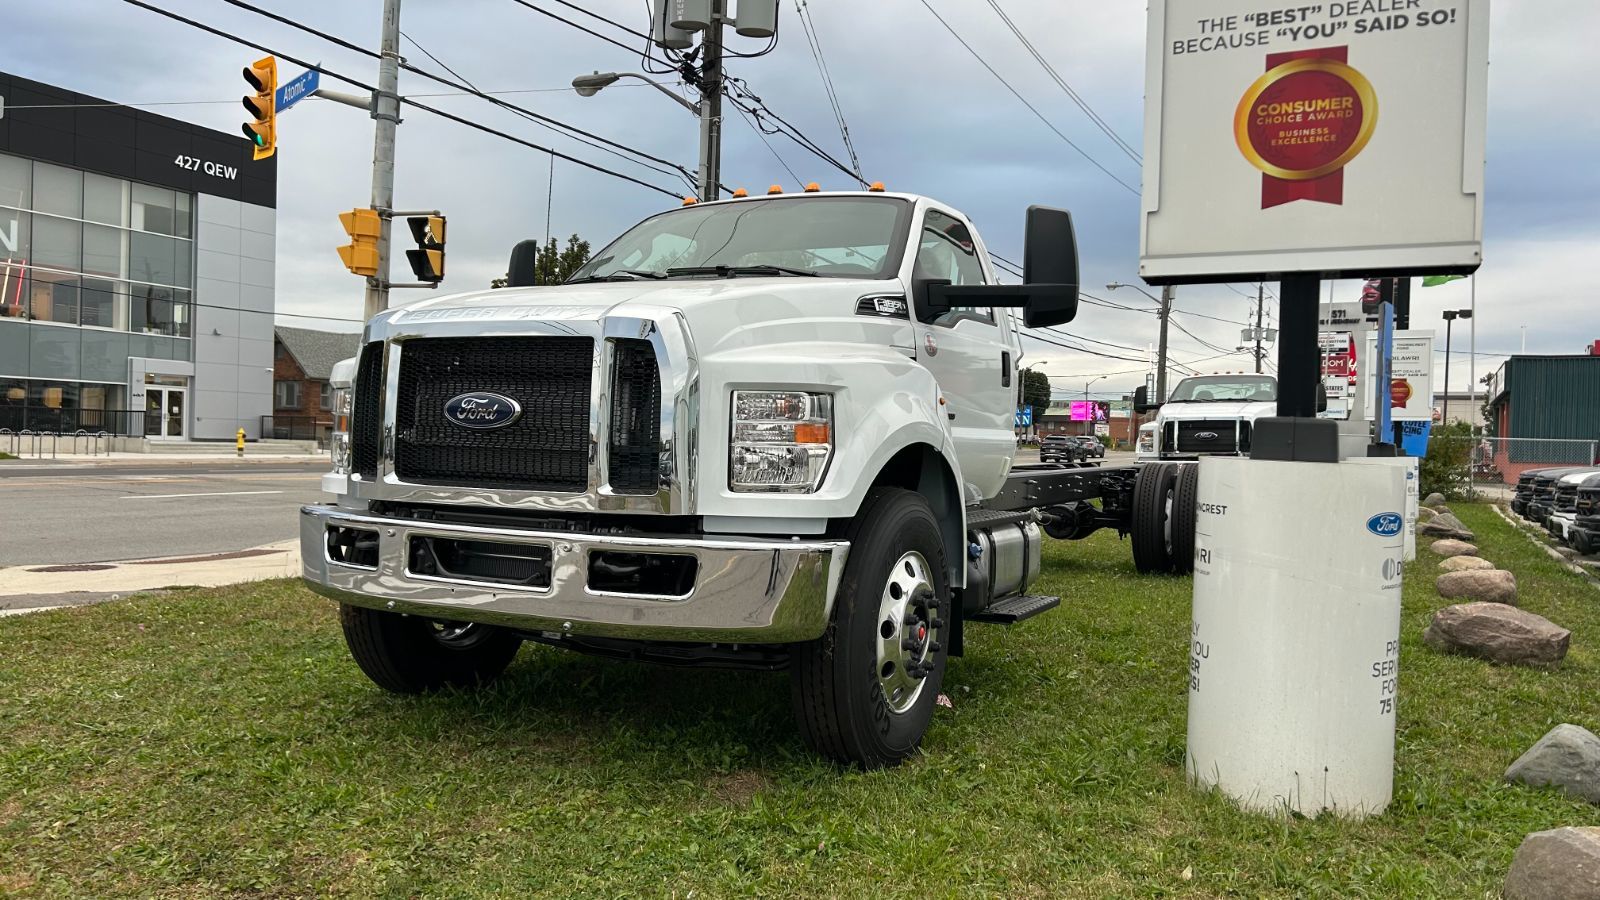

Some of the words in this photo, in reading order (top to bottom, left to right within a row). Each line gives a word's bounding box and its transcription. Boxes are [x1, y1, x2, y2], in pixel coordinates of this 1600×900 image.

[1198, 16, 1237, 34] THE
[1329, 0, 1420, 18] DEALER
[1173, 30, 1270, 55] BECAUSE
[1354, 14, 1409, 34] SAID
[1416, 8, 1456, 27] SO!
[283, 76, 306, 104] Atomic
[1256, 114, 1302, 125] CHOICE
[1308, 109, 1353, 121] AWARD
[1257, 96, 1353, 116] CONSUMER
[1271, 135, 1337, 146] EXCELLENCE
[1279, 127, 1329, 138] BUSINESS
[174, 154, 201, 171] 427
[203, 161, 238, 180] QEW
[457, 397, 499, 420] Ford
